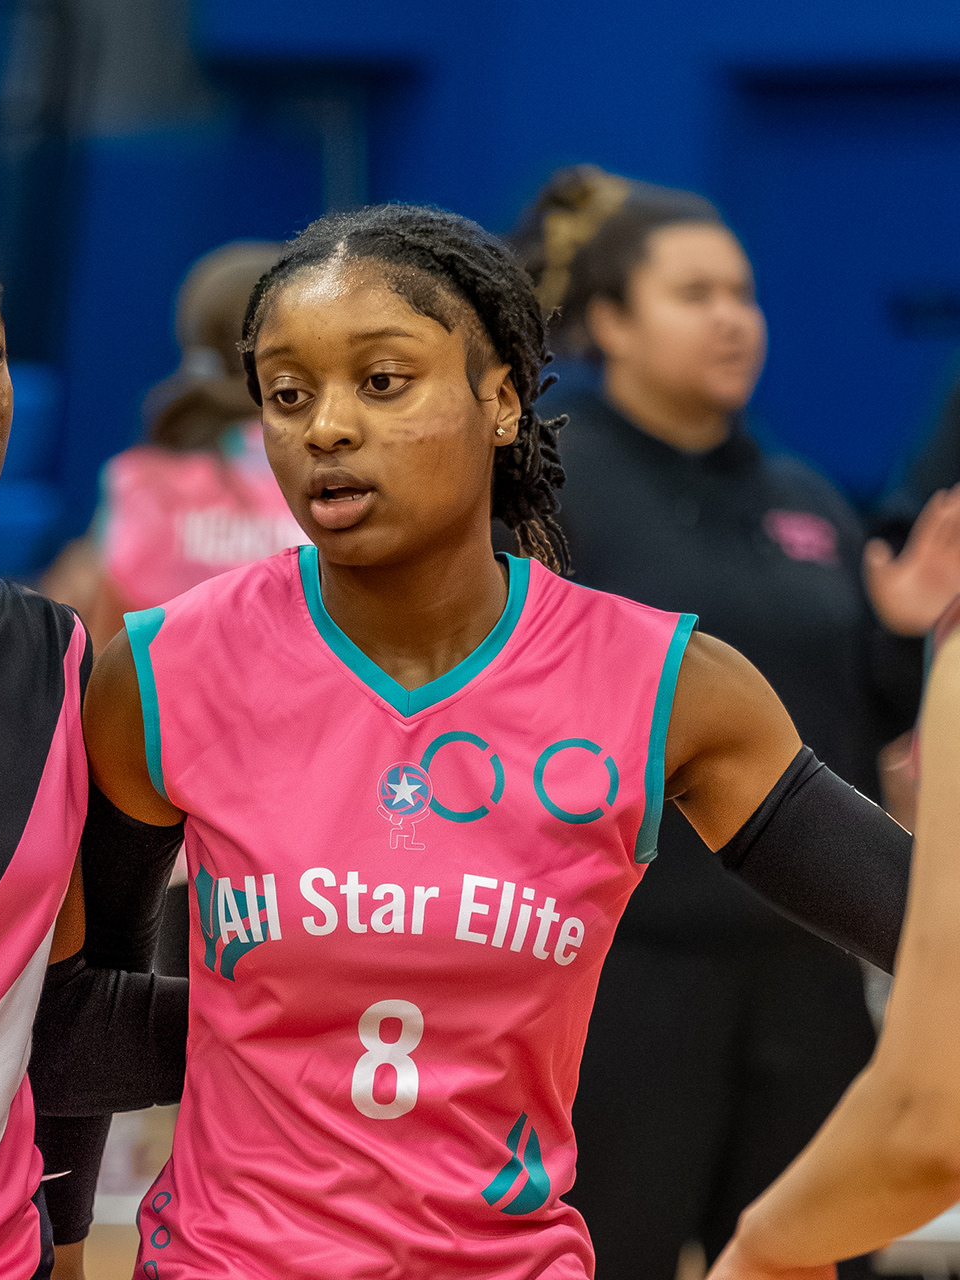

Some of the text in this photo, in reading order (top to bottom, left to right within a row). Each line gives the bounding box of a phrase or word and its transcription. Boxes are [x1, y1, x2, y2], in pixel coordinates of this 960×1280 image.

[216, 867, 586, 966] All Star Elite
[350, 999, 425, 1121] 8
